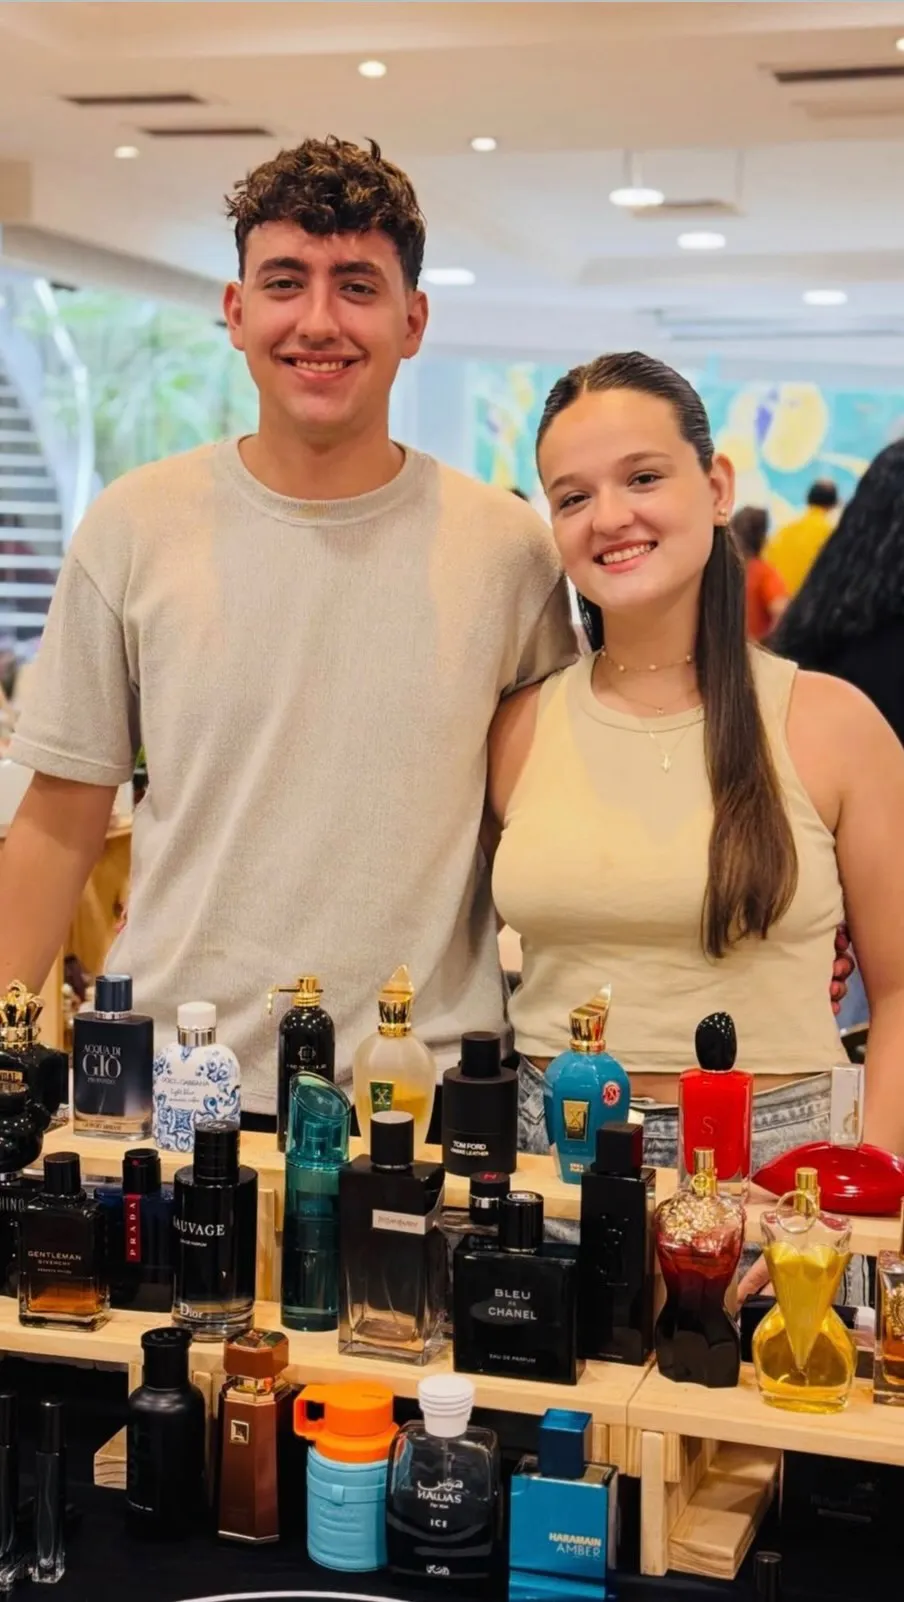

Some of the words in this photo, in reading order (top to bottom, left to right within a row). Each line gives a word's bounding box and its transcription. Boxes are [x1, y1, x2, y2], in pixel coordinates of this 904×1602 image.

[82, 1044, 110, 1055] ACQUA
[111, 1046, 121, 1056] DI
[452, 1140, 466, 1149] TOM
[467, 1142, 487, 1151] FORD
[129, 1202, 137, 1256] PRADA
[27, 1250, 82, 1261] GENTLEMAN
[494, 1287, 531, 1300] BLEU
[180, 1302, 203, 1319] Dior
[488, 1306, 538, 1321] CHANEL
[417, 1490, 462, 1504] HAWAS
[430, 1518, 448, 1529] ICE
[548, 1531, 602, 1548] HARAMAIN
[556, 1543, 602, 1558] AMBER
